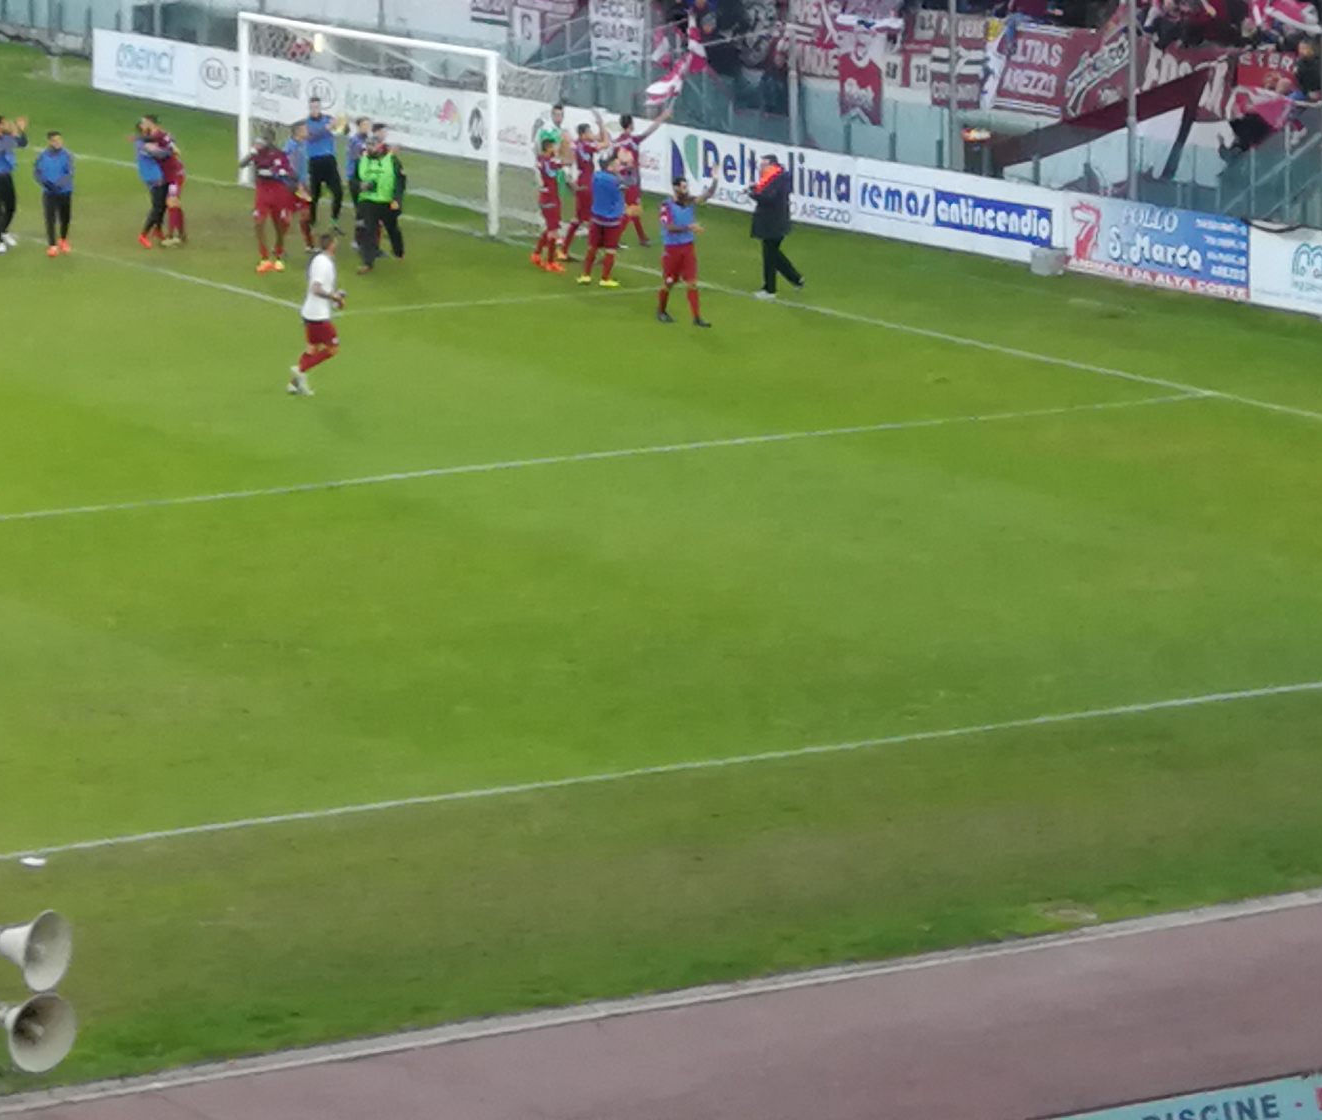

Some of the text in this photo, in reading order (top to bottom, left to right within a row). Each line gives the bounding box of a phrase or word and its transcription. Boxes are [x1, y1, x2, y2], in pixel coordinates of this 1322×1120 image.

[800, 202, 852, 225] AREZZO
[860, 182, 931, 218] remas
[937, 197, 1051, 241] antincendio
[1122, 205, 1178, 233] POLLO
[1129, 232, 1202, 271] Marco
[1154, 272, 1193, 291] ALTA
